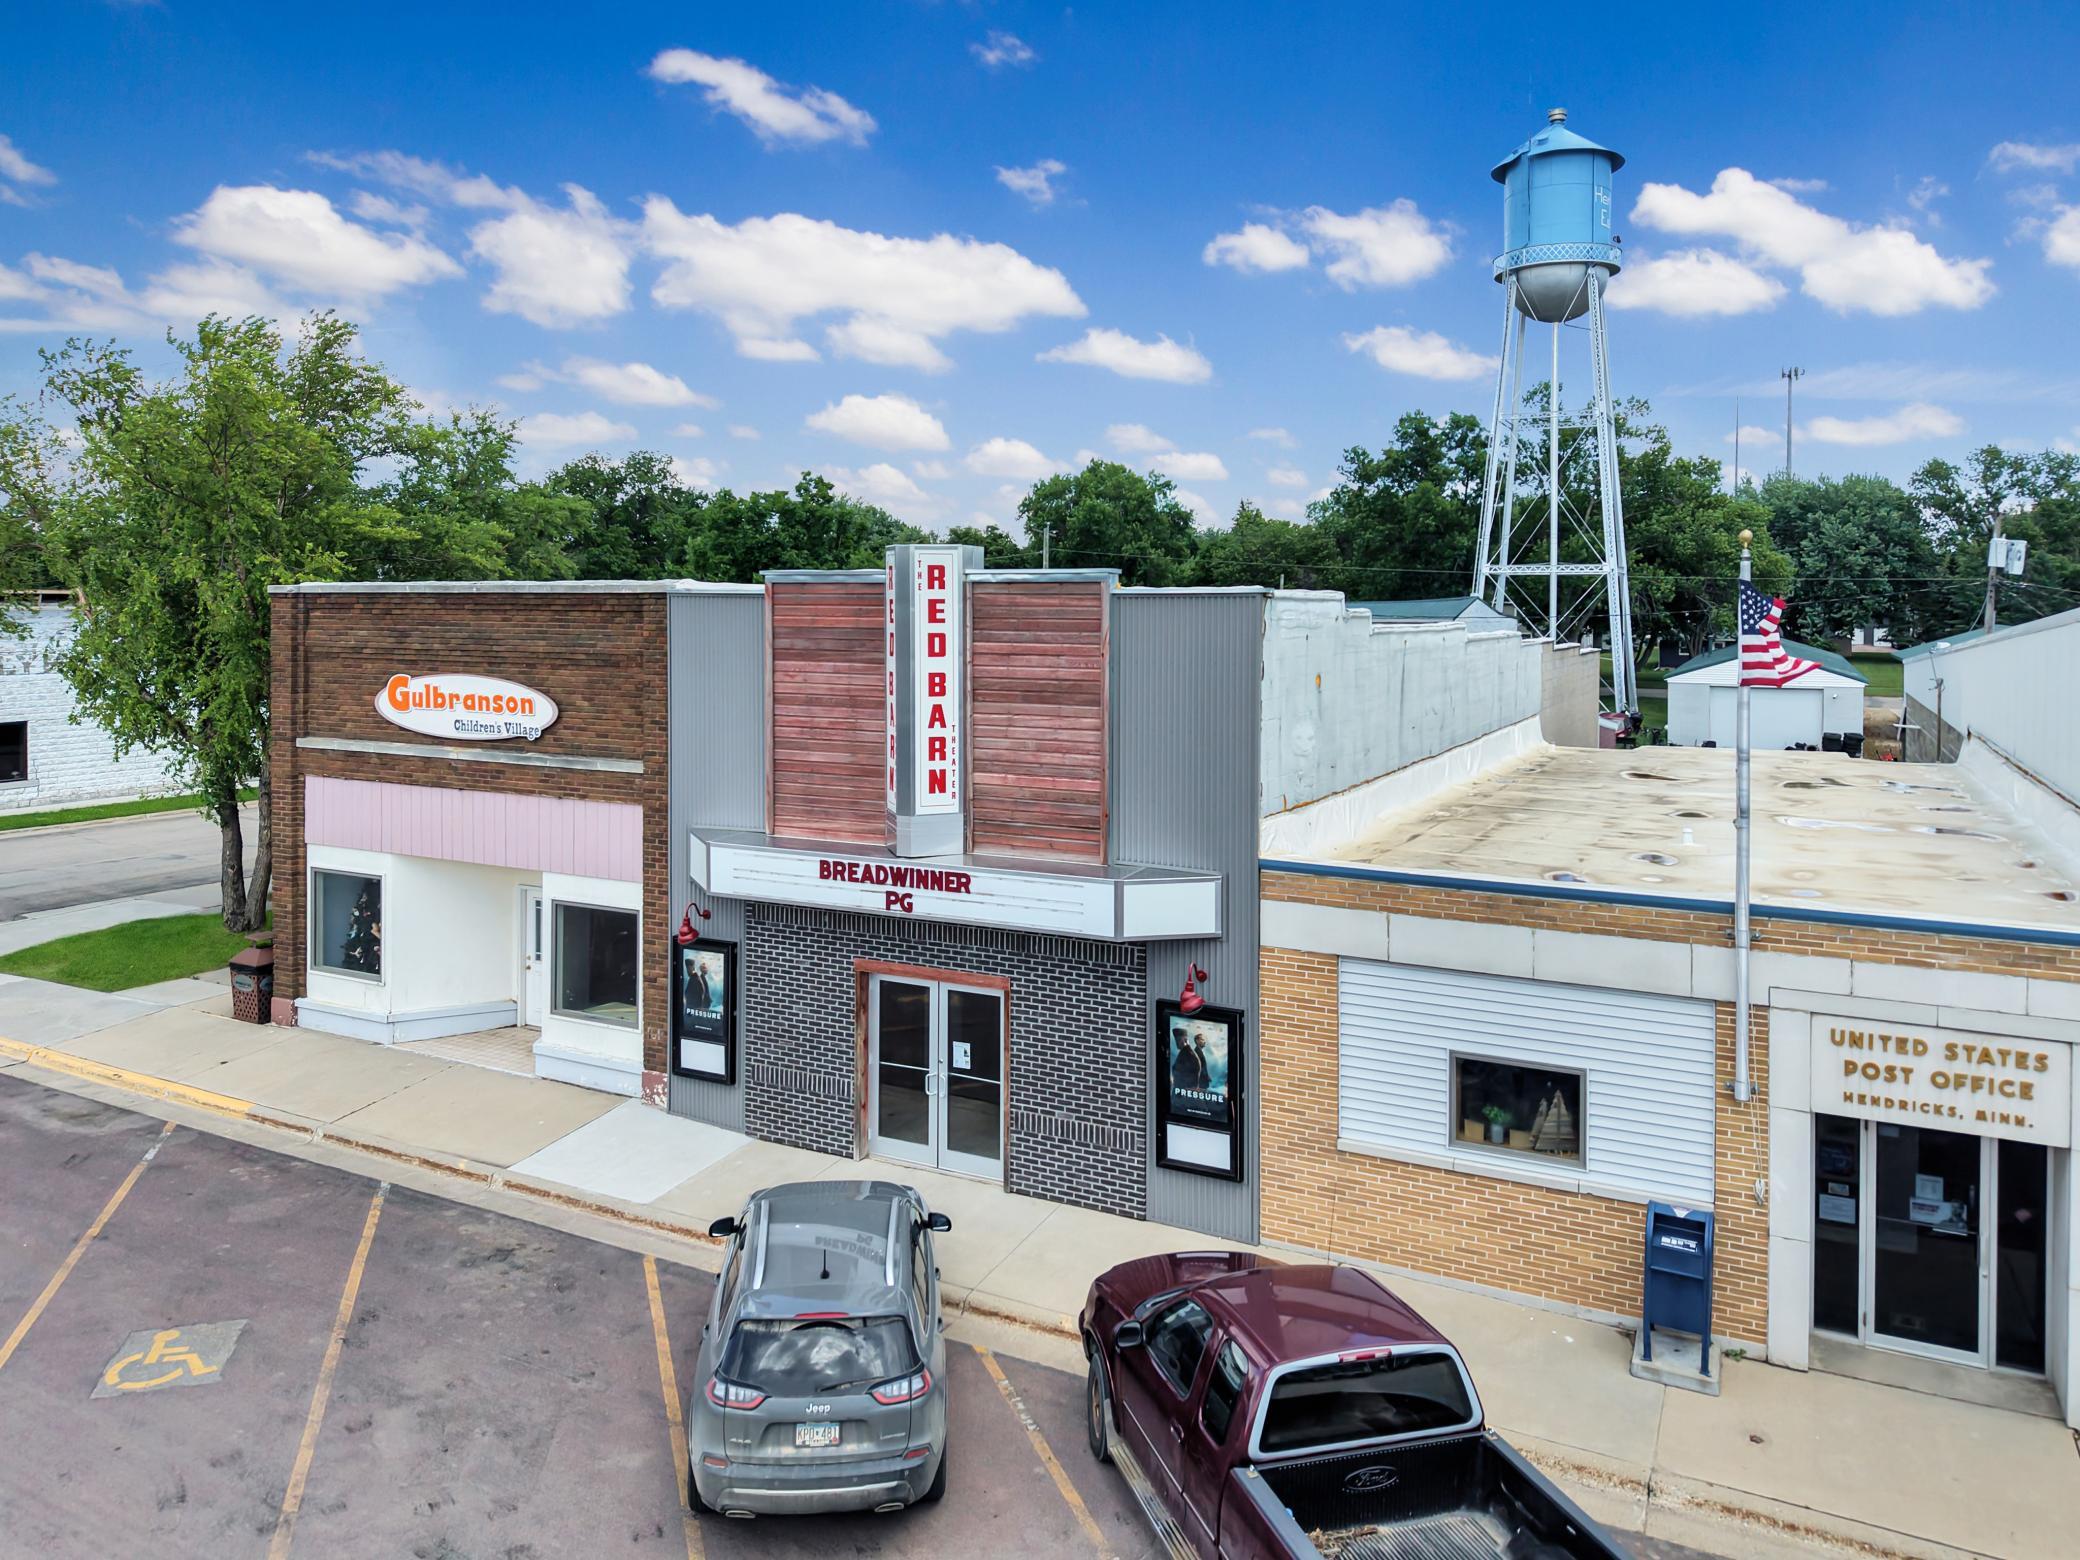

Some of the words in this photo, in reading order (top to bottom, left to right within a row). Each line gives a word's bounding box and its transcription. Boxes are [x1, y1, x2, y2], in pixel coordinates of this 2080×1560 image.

[927, 564, 947, 657] RED
[387, 675, 535, 715] Gulbranson
[454, 719, 502, 734] Children's
[504, 721, 540, 740] Village
[927, 672, 947, 794] BARN
[819, 859, 972, 894] BREADWINNER
[885, 890, 913, 913] PG
[686, 1008, 721, 1020] PRESSURE
[1830, 1028, 1929, 1057] UNITED
[1944, 1042, 2049, 1073] STATES
[1174, 1087, 1224, 1103] PRESSURE
[1844, 1059, 1914, 1085] POST
[1930, 1071, 2034, 1100] OFFICE
[1843, 1091, 1964, 1120] HENDRICKS,
[1975, 1109, 2034, 1128] MINN.
[805, 1402, 831, 1415] Jeep
